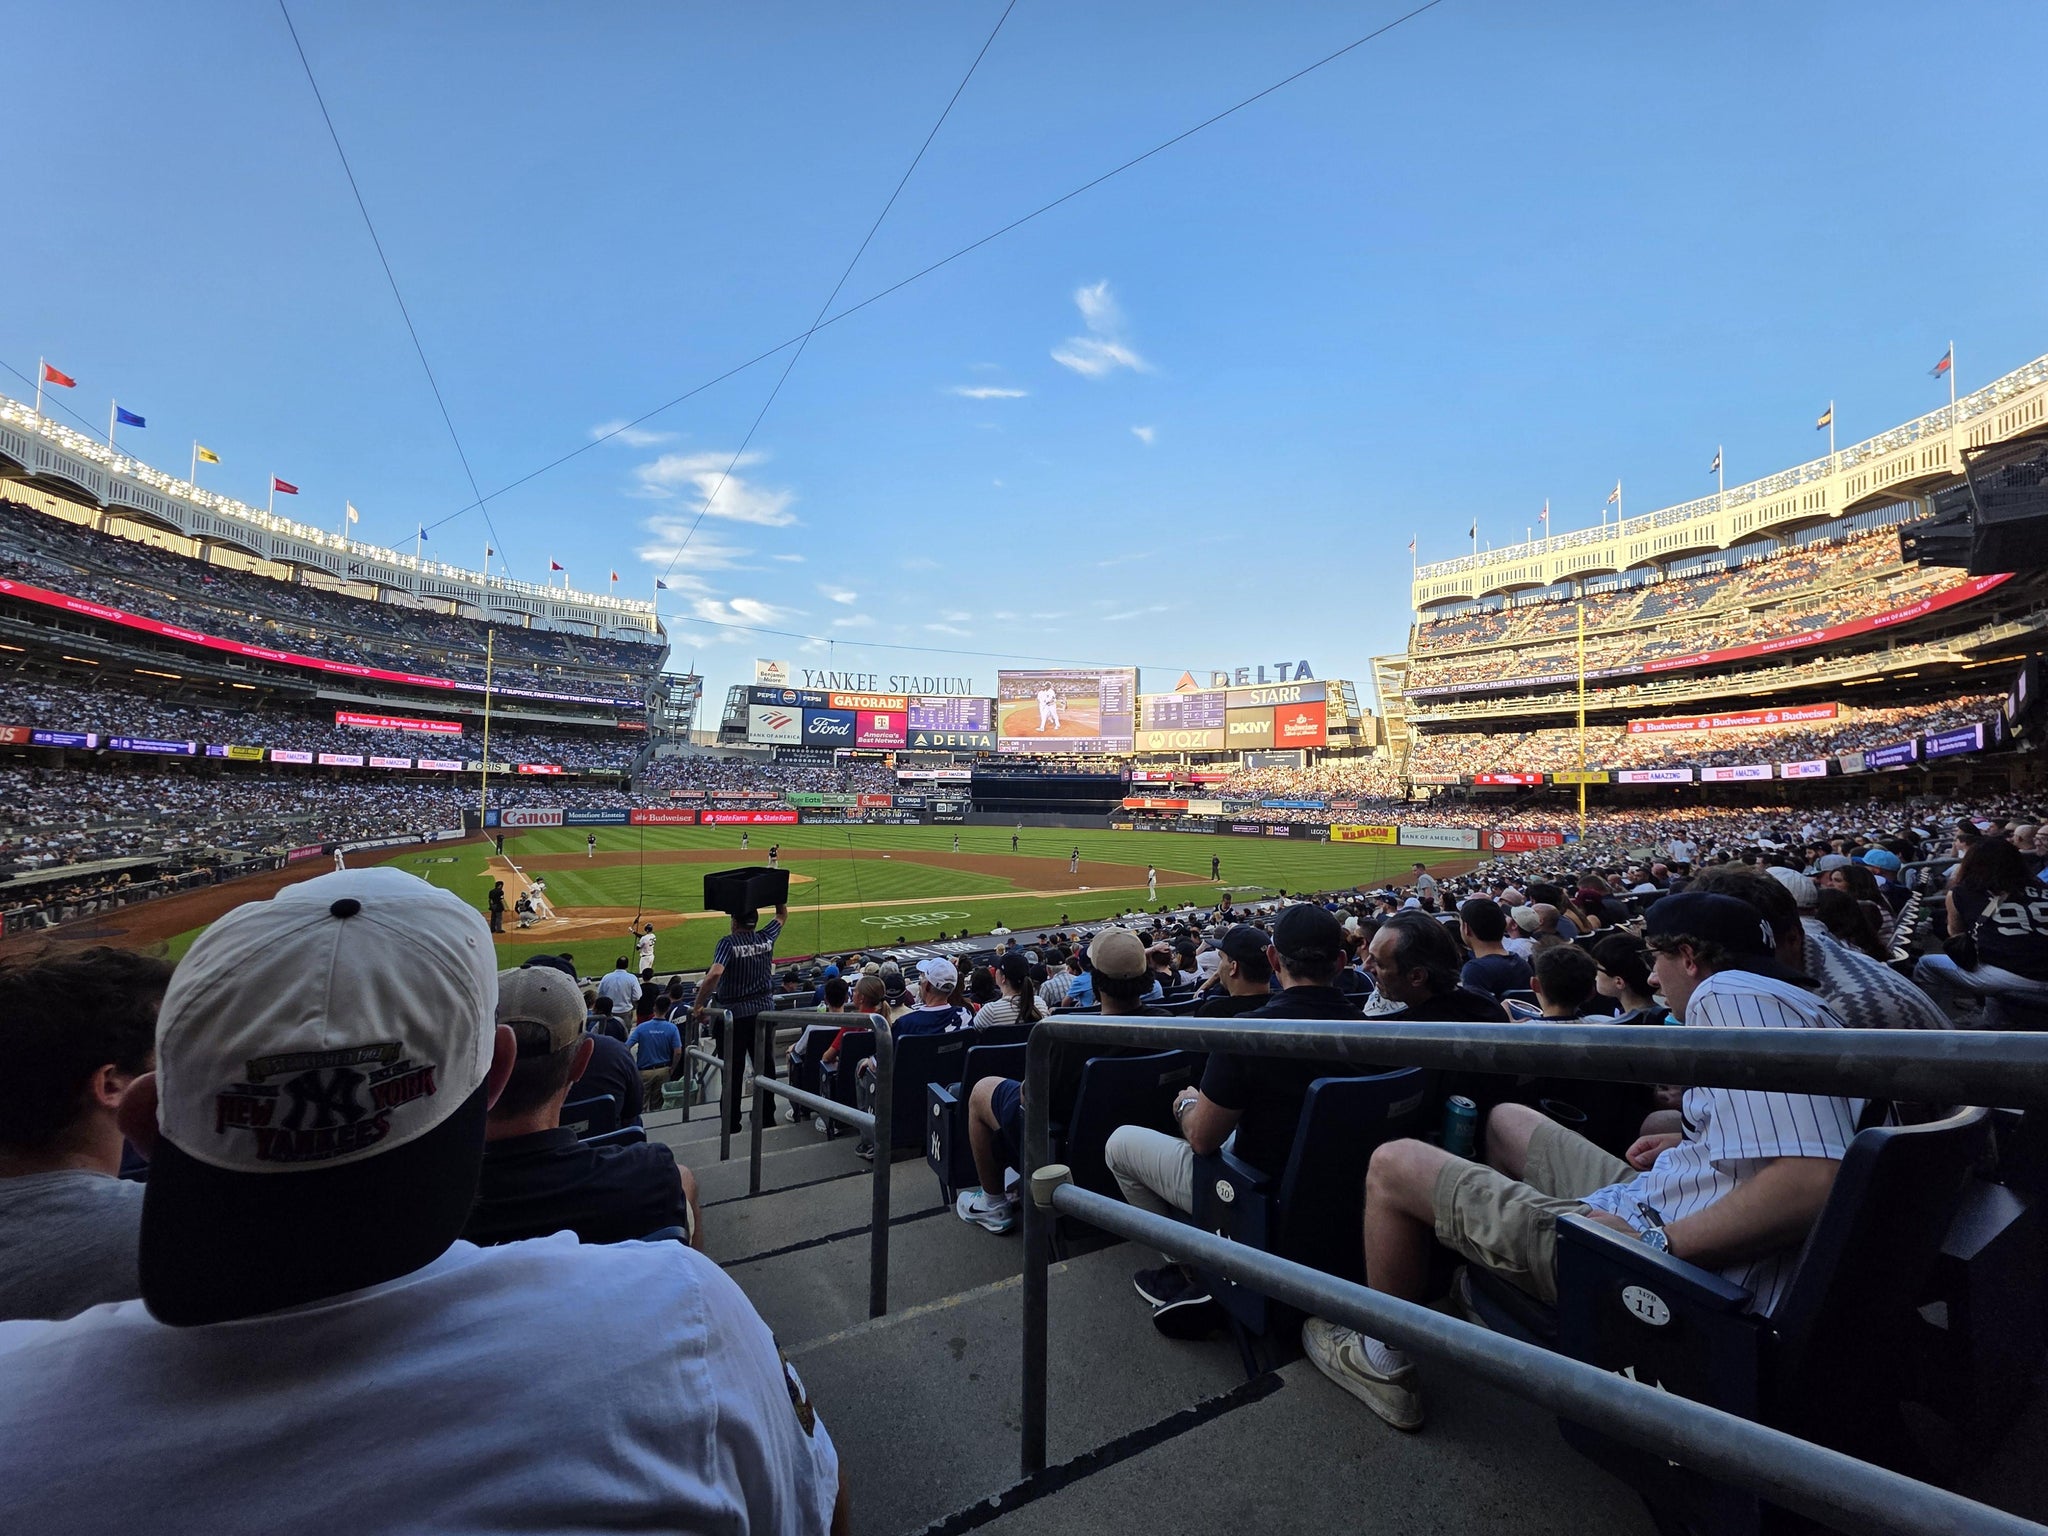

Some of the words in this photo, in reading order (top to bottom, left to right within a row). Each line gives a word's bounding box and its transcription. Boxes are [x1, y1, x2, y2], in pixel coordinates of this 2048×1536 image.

[39, 561, 70, 575] VODKA
[67, 601, 80, 609] BANK
[90, 607, 113, 618] AMERICA
[1874, 616, 1891, 625] BANK
[1891, 613, 1900, 621] OF
[1899, 606, 1922, 620] AMERICA
[179, 631, 198, 640] AMERICA
[1762, 642, 1777, 650] BANK
[1786, 636, 1813, 646] AMERICA
[259, 650, 278, 659] AMERICA
[1651, 661, 1666, 669] BANK
[1675, 657, 1698, 666] AMERICA
[342, 666, 362, 674] AMERICA
[760, 671, 786, 680] Benjamin
[1210, 660, 1315, 689] DELTA
[802, 669, 878, 692] YANKEE
[889, 675, 973, 695] STADIUM
[1457, 682, 1489, 692] SUPPORT,
[1489, 679, 1515, 688] FASTER
[1515, 677, 1535, 685] THAN
[1535, 676, 1550, 684] THE
[1551, 673, 1573, 682] PITCH
[1573, 671, 1599, 681] COCK
[507, 689, 534, 698] SUPPORT,
[534, 691, 554, 699] FASTER
[1250, 686, 1302, 705] STARR
[834, 696, 904, 709] GATORADE
[348, 716, 379, 725] Budweiser
[1781, 708, 1832, 721] Budweiser
[390, 720, 420, 728] Budweiser
[808, 717, 851, 735] Ford
[1647, 721, 1694, 731] Budweiser
[1712, 715, 1761, 727] Budweiser
[430, 723, 460, 732] Budweiser
[1229, 721, 1272, 735] DKNY
[1284, 723, 1318, 733] Budweiser
[934, 735, 991, 747] DELTA
[1168, 731, 1212, 748] razr
[435, 761, 459, 769] AMAZING
[475, 763, 502, 771] ORIS
[1801, 764, 1821, 773] AMAZING
[1650, 772, 1680, 780] AMAZING
[1735, 769, 1760, 777] AMAZING
[502, 811, 562, 825] Canon
[568, 811, 601, 819] Montefiore
[601, 811, 626, 819] Einstein
[649, 814, 693, 822] Budweiser
[1506, 833, 1525, 844] F.W.
[1527, 834, 1557, 845] WEBB
[733, 940, 773, 958] VENDOR
[356, 1048, 384, 1062] 1903
[369, 1064, 437, 1111] YORK
[216, 1093, 278, 1134] NEW
[255, 1110, 392, 1161] YANKEES
[1221, 1188, 1230, 1199] 10
[1638, 1289, 1657, 1303] 117B
[1635, 1299, 1656, 1319] 11
